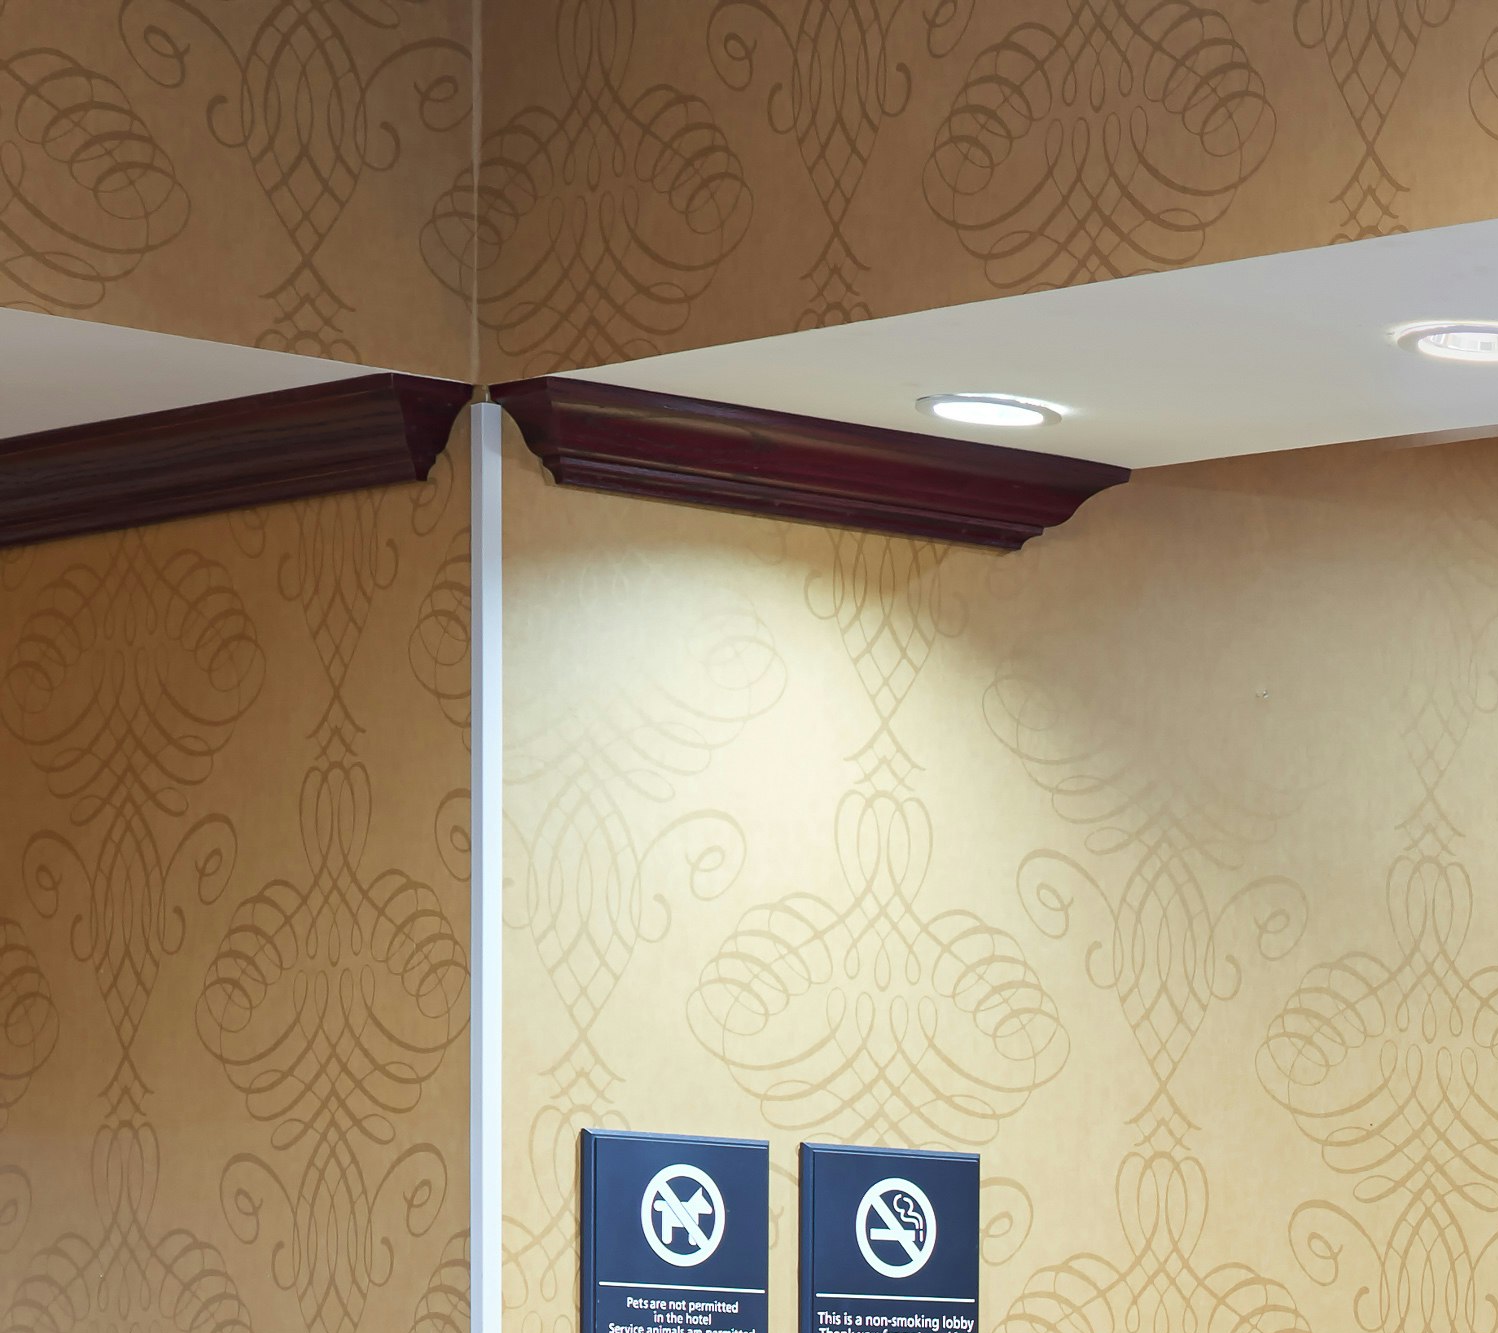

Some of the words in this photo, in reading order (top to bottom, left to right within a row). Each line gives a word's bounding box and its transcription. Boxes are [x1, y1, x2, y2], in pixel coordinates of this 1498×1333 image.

[627, 1297, 648, 1309] Pets
[650, 1301, 666, 1310] are
[669, 1300, 686, 1311] not
[689, 1301, 739, 1313] permitted
[654, 1311, 664, 1323] in
[666, 1312, 683, 1324] the
[686, 1313, 712, 1325] hotel
[817, 1311, 841, 1325] This
[844, 1312, 852, 1325] is
[855, 1315, 862, 1326] a
[865, 1314, 940, 1331] non-smoking
[942, 1314, 974, 1332] lobby
